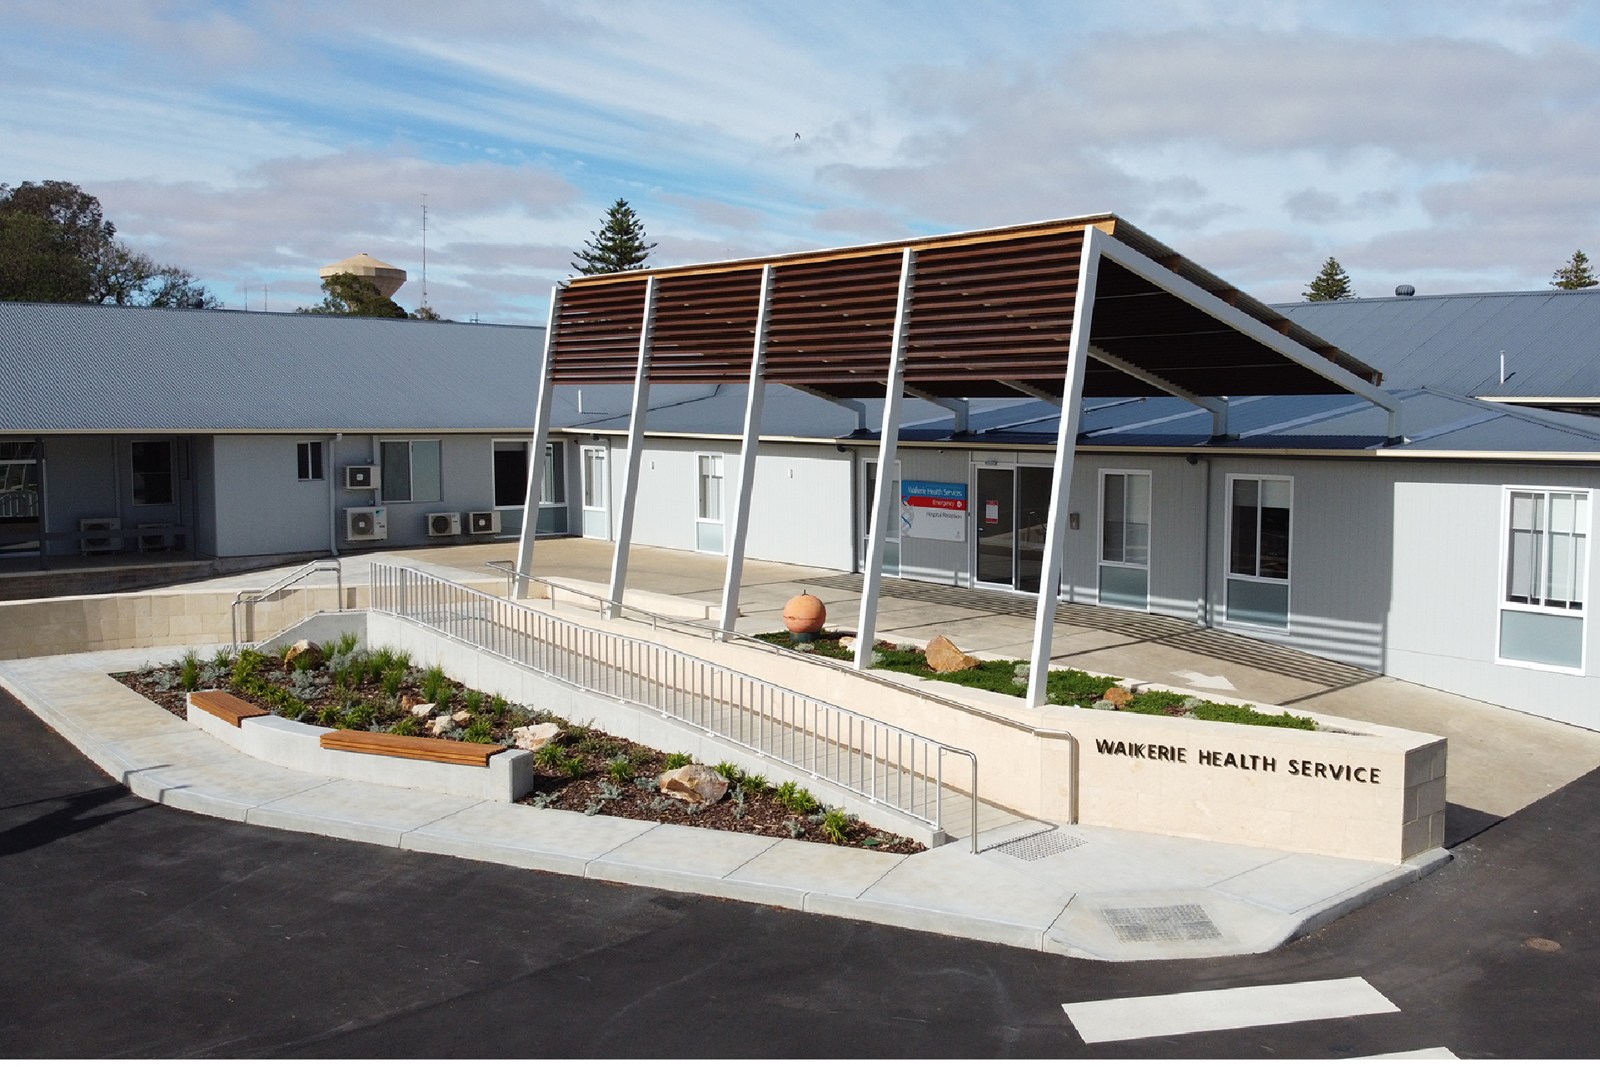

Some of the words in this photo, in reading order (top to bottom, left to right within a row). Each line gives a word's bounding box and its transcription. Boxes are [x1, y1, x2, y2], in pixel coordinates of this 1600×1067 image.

[907, 486, 926, 495] Waikerie
[943, 489, 963, 497] Services
[932, 499, 955, 507] Emergency
[1095, 738, 1187, 763] WAIKERIE
[1198, 749, 1277, 772] HEALTH
[1287, 759, 1382, 785] SERVICE
